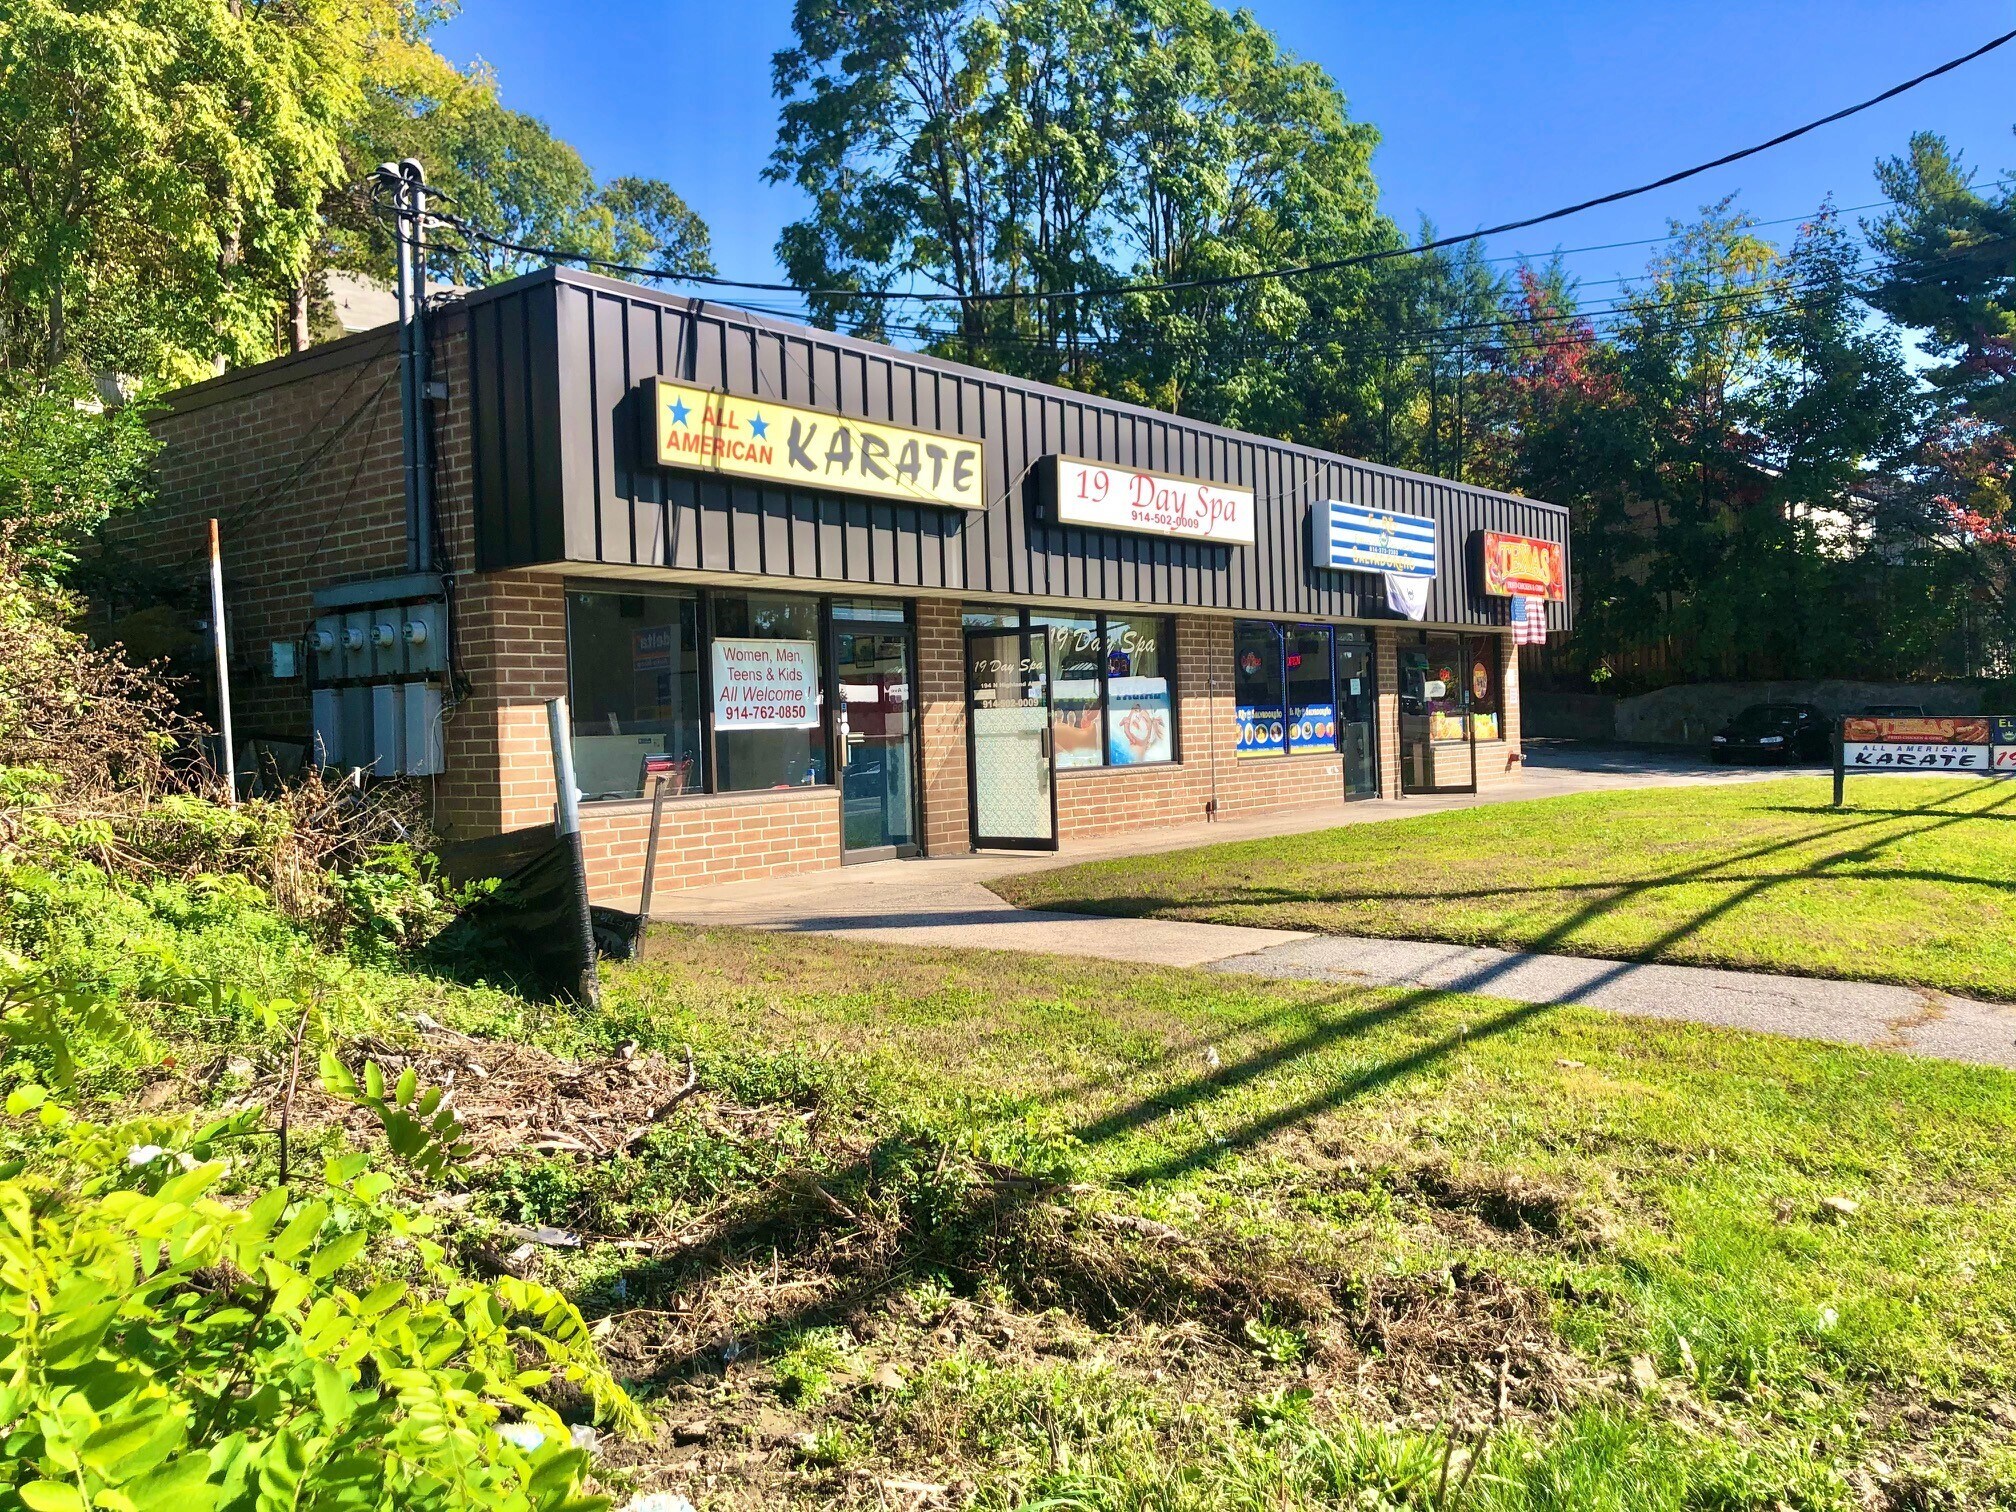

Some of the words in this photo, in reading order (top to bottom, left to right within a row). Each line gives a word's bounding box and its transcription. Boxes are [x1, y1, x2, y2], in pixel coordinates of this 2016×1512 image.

[701, 405, 739, 430] ALL
[666, 434, 773, 465] AMERICAN
[787, 415, 976, 492] KARATE
[1076, 469, 1110, 502] 19
[1129, 473, 1187, 531] Day
[1195, 484, 1237, 536] Spa
[1131, 510, 1199, 529] 914-502-0009
[1498, 541, 1551, 586] TEXAS
[1050, 626, 1069, 651] 19
[1074, 628, 1116, 657] Day
[1120, 631, 1156, 658] Spa
[723, 647, 773, 663] Women,
[776, 648, 804, 664] Men,
[727, 667, 762, 681] Teens
[766, 667, 775, 681] &
[778, 668, 803, 681] Kids
[974, 660, 987, 672] 19
[990, 659, 1015, 674] Day
[1019, 659, 1045, 673] Spa
[720, 686, 738, 702] All
[743, 686, 803, 701] Welcome
[982, 698, 1039, 708] 914-502-0009
[725, 705, 806, 720] 914-762-0850
[1877, 718, 1954, 737] TEXAS
[1896, 745, 1969, 753] AMERICAN
[1855, 752, 1977, 767] KARATE
